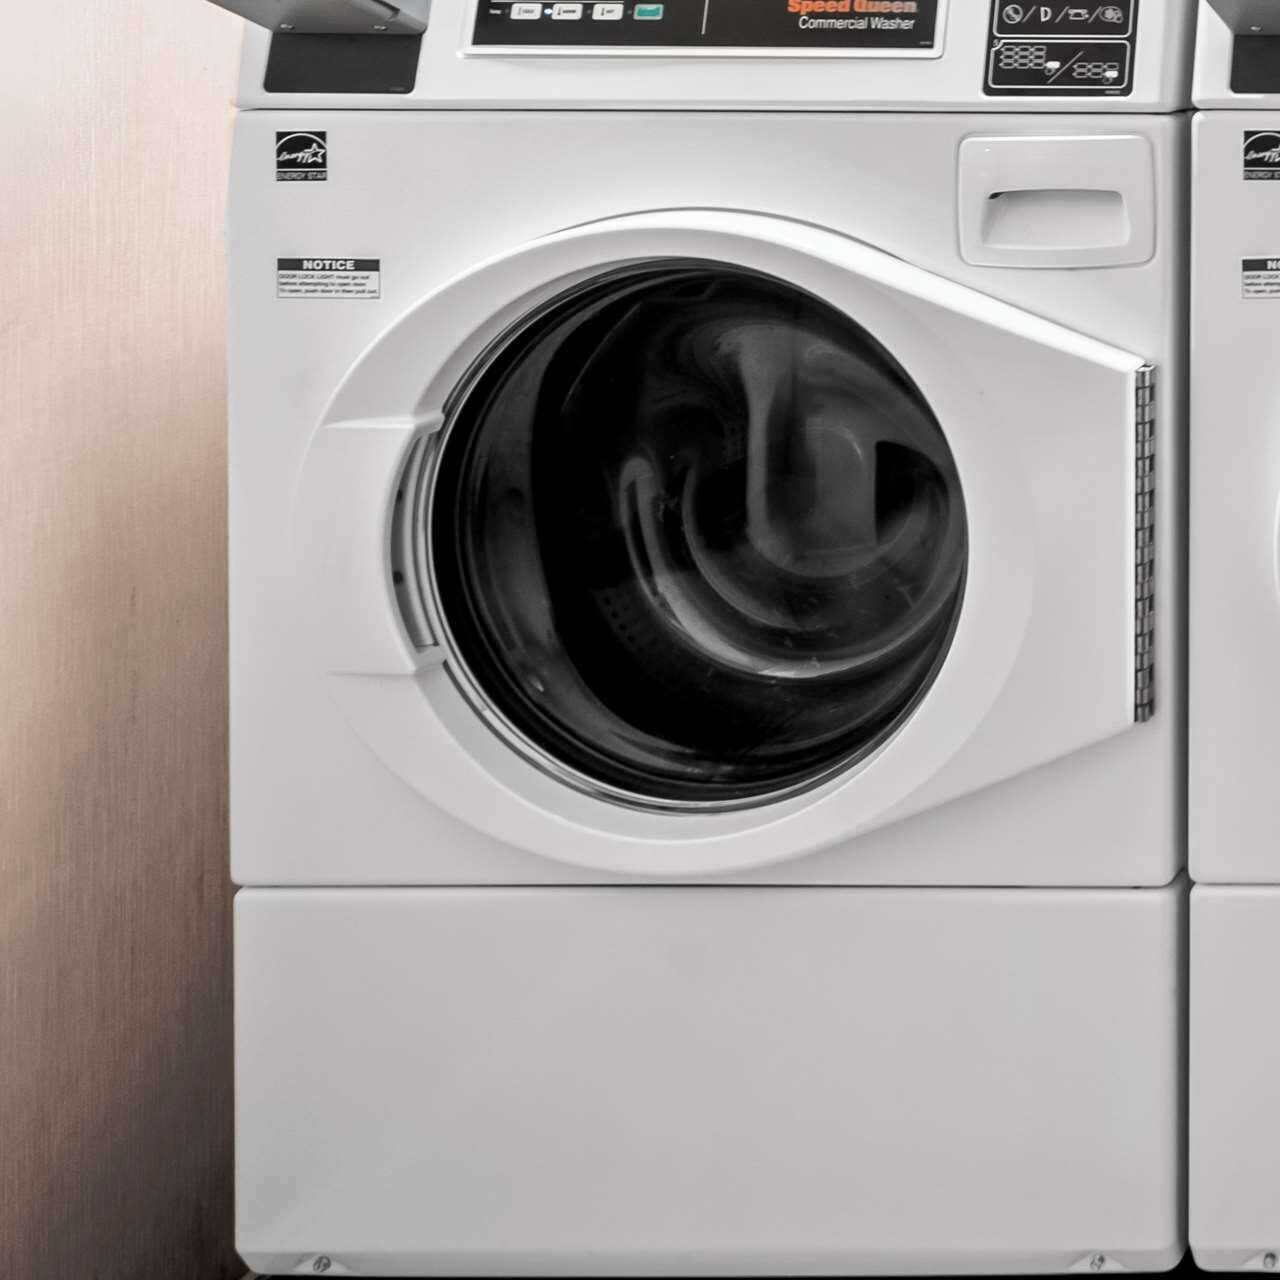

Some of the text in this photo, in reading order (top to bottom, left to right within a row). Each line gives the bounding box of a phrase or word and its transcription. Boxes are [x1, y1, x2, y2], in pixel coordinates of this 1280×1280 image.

[798, 16, 915, 29] Commercial Washer
[303, 260, 355, 270] NOTICE
